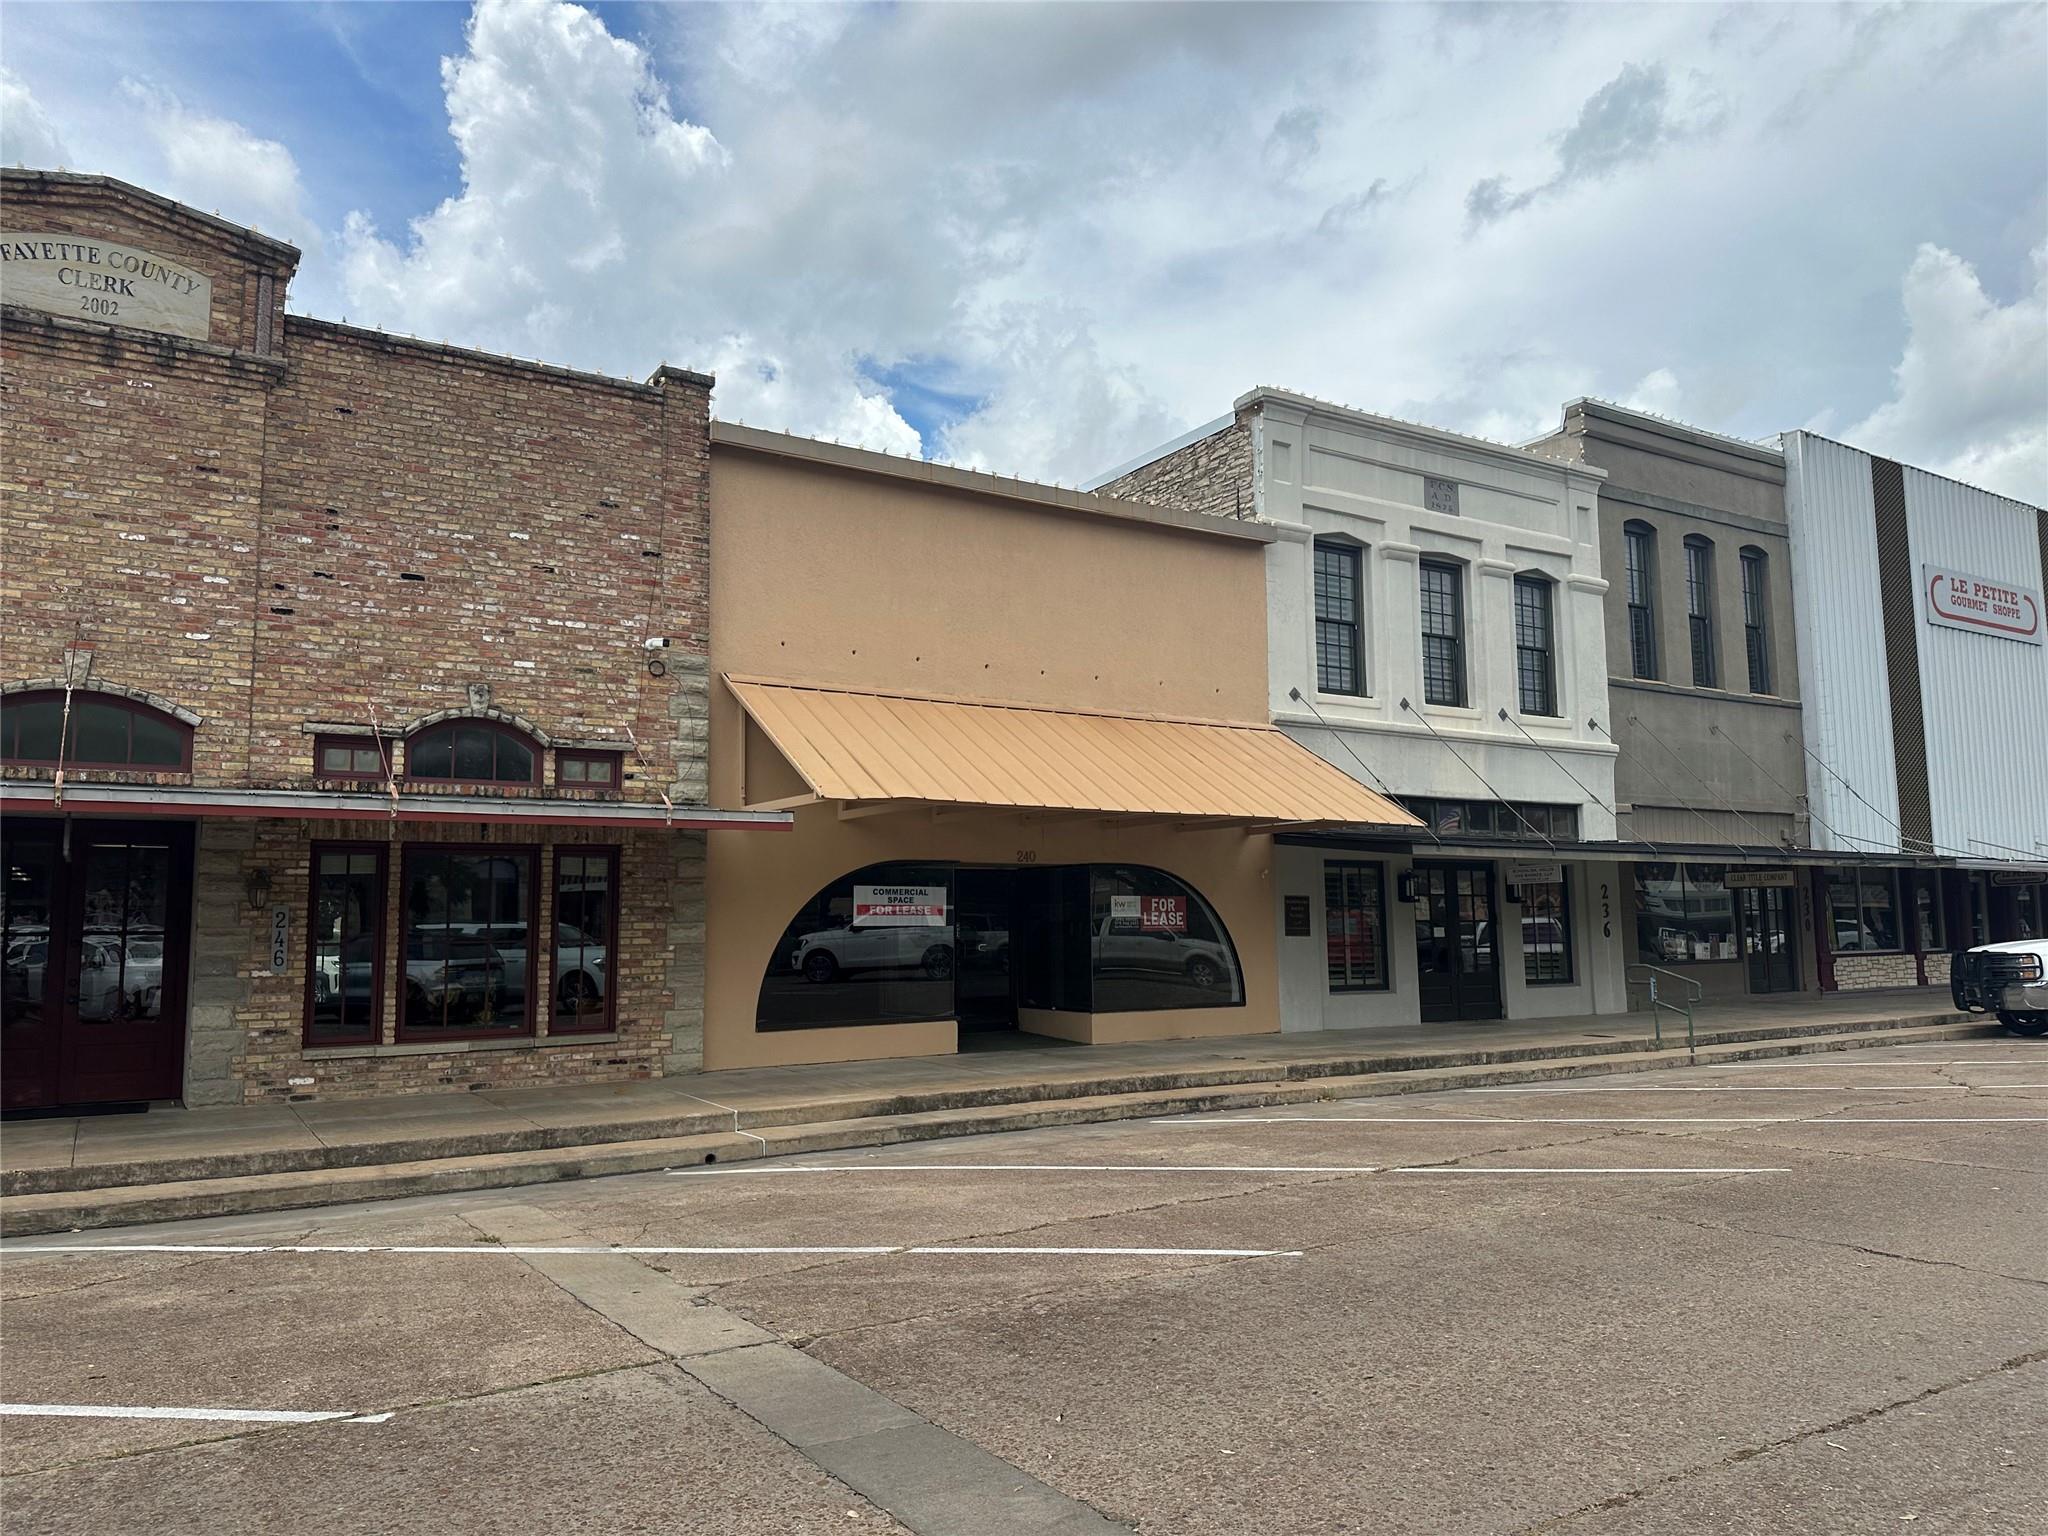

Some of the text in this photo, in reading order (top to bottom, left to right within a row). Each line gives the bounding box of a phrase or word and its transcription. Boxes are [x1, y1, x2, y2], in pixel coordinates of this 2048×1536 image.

[0, 242, 201, 295] FAYETTE COUNTY
[57, 267, 136, 298] CLERK
[79, 295, 119, 316] 2002
[1950, 577, 2019, 606] LE PETITE
[1950, 595, 2021, 619] GOURMET SHOPPE
[1016, 850, 1037, 863] 240
[872, 888, 929, 896] COMMERCIAL
[887, 896, 915, 904] SPACE
[869, 905, 932, 915] FOR LEASE
[1151, 898, 1176, 912] FOR
[1600, 883, 1611, 938] 236
[1143, 911, 1184, 926] LEASE
[274, 911, 286, 967] 246
